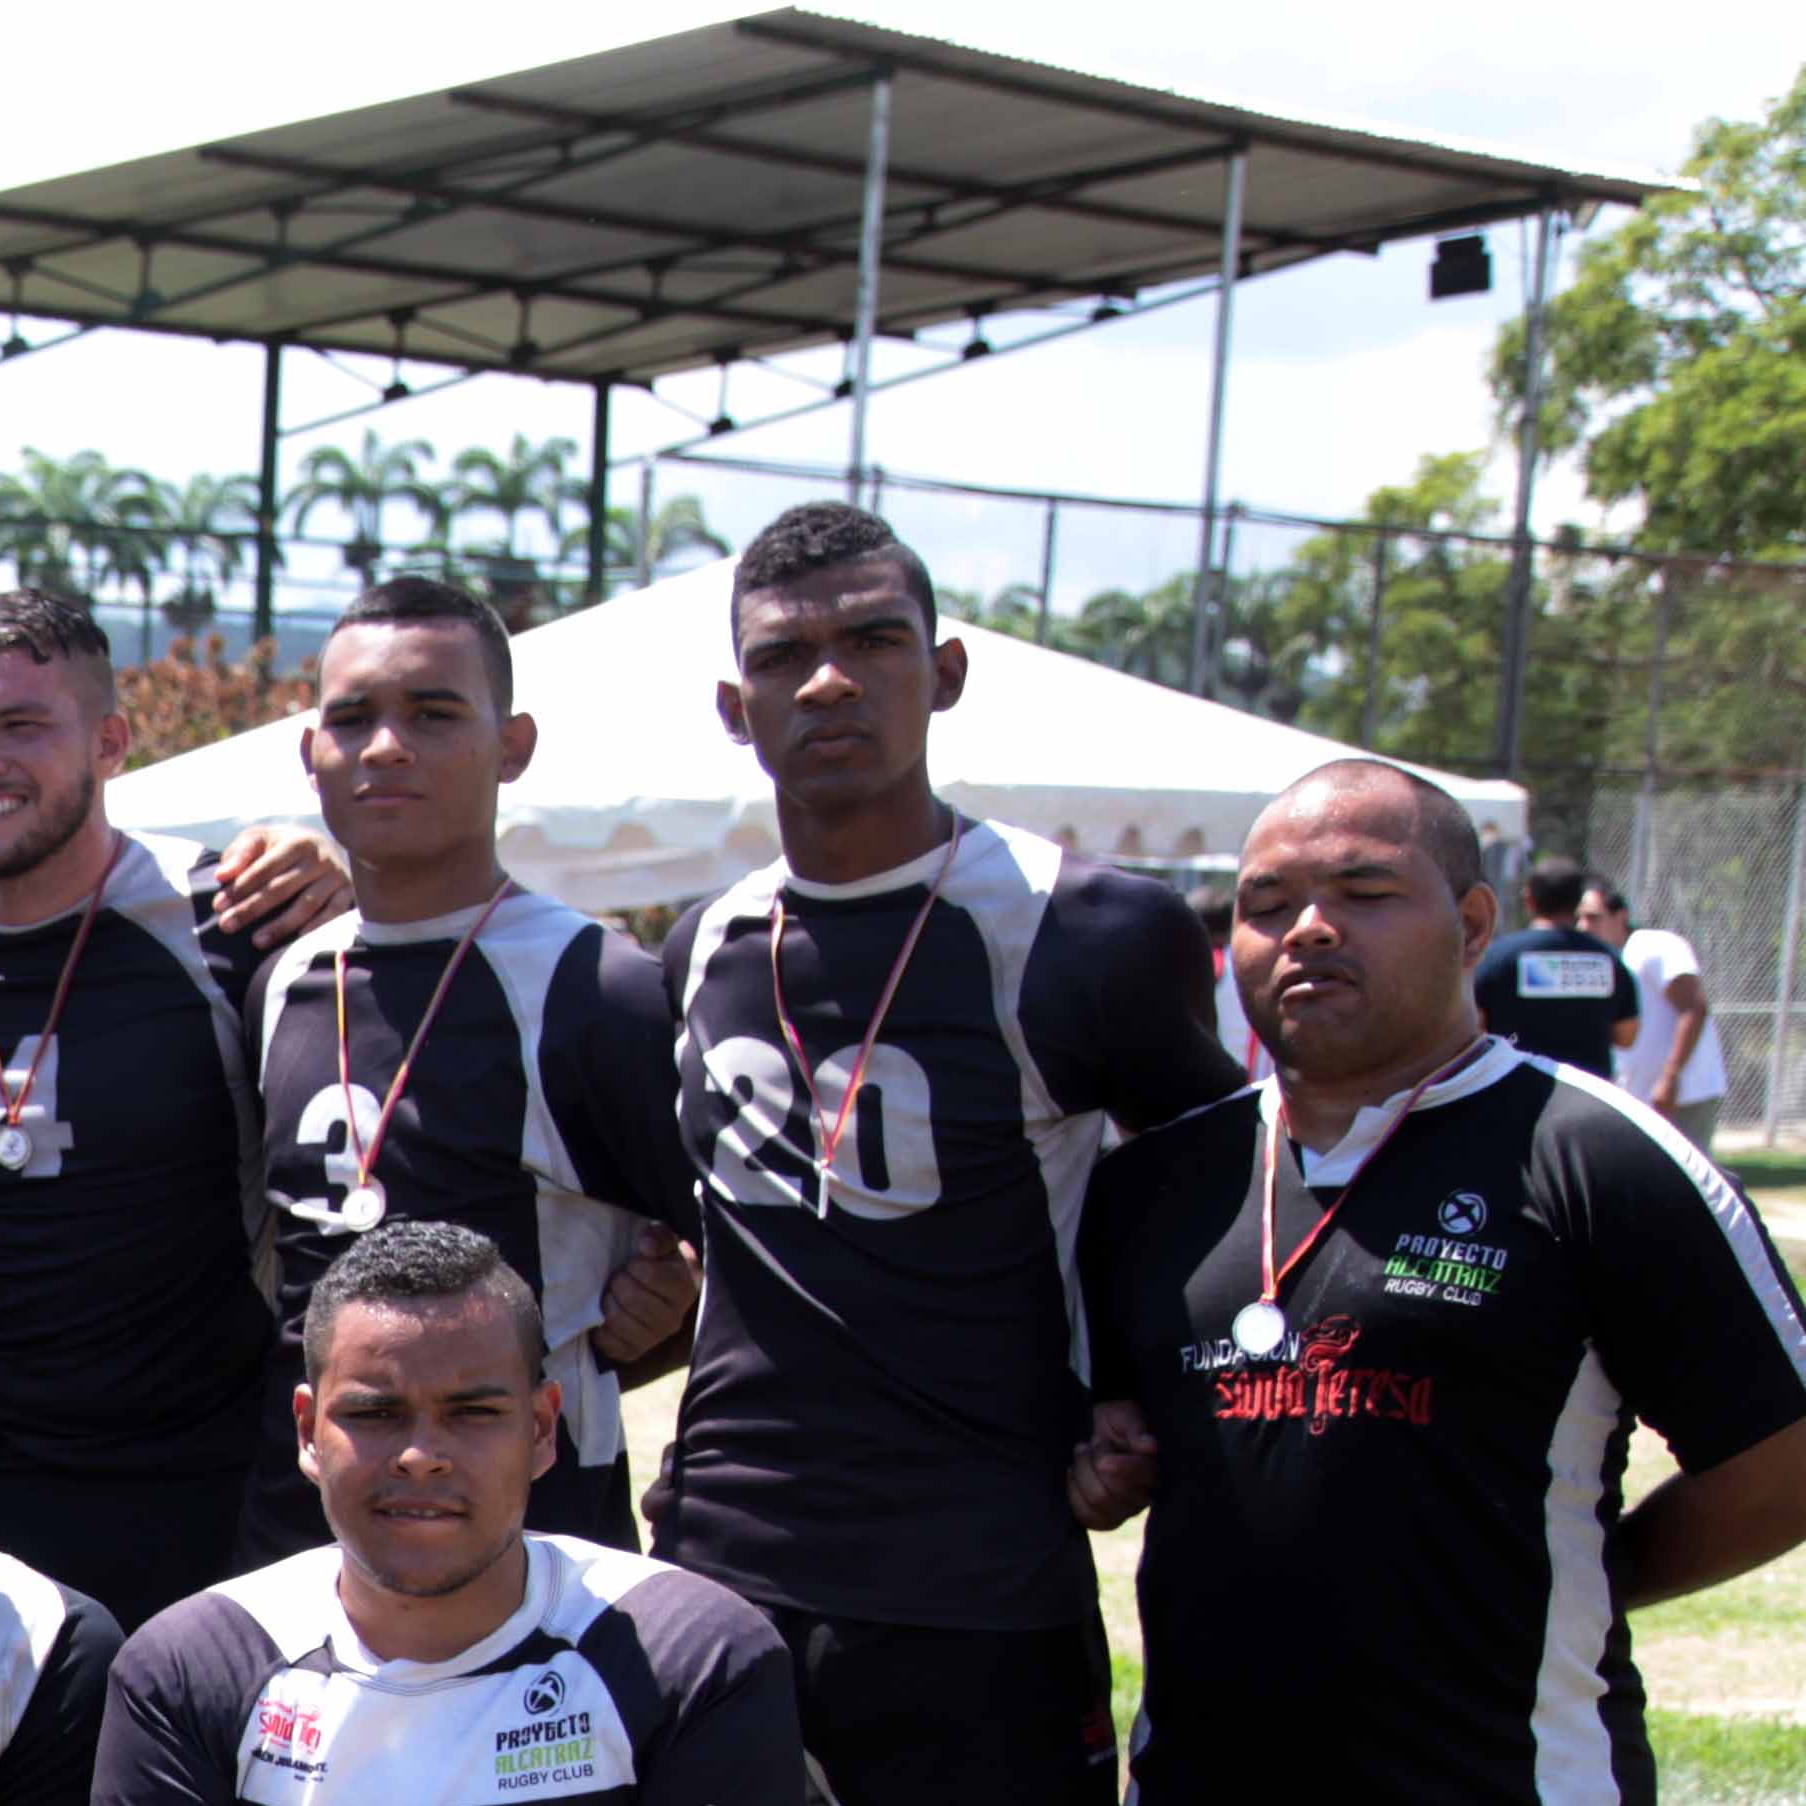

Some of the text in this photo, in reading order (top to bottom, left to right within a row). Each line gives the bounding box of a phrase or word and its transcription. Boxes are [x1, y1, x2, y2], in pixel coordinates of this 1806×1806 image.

[704, 1036, 942, 1220] 20
[1395, 1233, 1508, 1270] PROYECTO
[1383, 1255, 1502, 1294] ALCATRAZ
[1384, 1277, 1483, 1307] RUGBY CLUB
[496, 1711, 591, 1752] PROYECTO
[495, 1736, 595, 1776] ALCATRAZ
[498, 1763, 595, 1791] RUGBY CLUB
